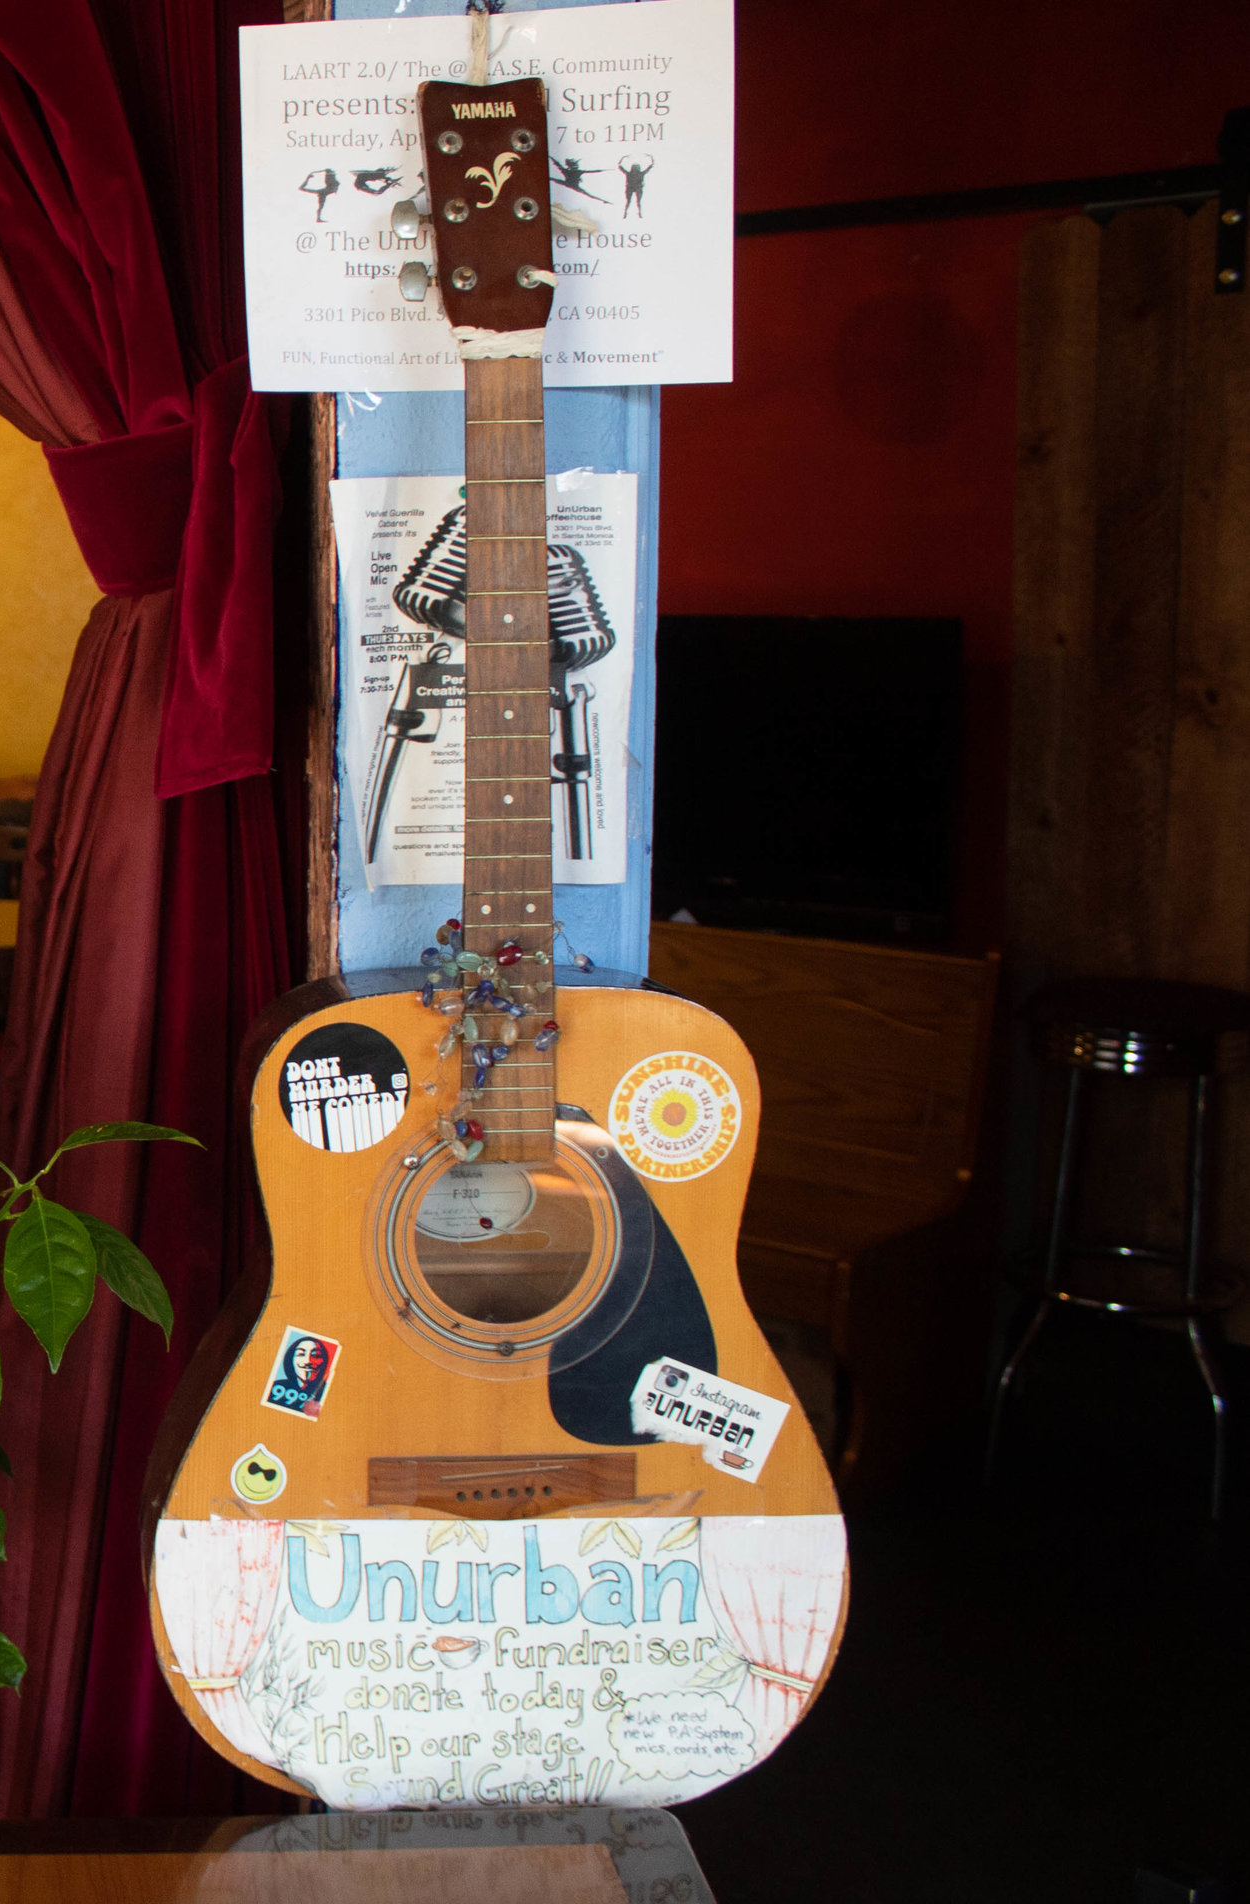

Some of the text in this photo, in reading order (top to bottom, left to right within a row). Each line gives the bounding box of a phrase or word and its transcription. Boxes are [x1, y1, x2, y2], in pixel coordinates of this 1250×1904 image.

[282, 61, 351, 82] LAART
[357, 60, 399, 82] 2.0/
[404, 60, 442, 78] The
[552, 53, 673, 75] Community
[282, 94, 416, 124] presents:
[561, 85, 672, 117] Surfing
[451, 101, 517, 120] YAMAHA
[286, 128, 384, 152] Saturday,
[555, 125, 568, 145] 7
[574, 126, 596, 144] to
[604, 121, 664, 143] 11PM
[295, 231, 317, 253] @
[325, 230, 370, 252] The
[577, 229, 652, 249] House
[304, 307, 345, 322] 3301
[351, 307, 386, 322] Pico
[390, 307, 431, 322] Blvd.
[558, 306, 580, 320] CA
[585, 305, 640, 321] 90405
[282, 351, 316, 367] FUN,
[320, 351, 395, 366] Functional
[399, 351, 423, 365] Art
[425, 351, 442, 365] of
[556, 351, 568, 364] &
[557, 505, 602, 513] UnUrban
[404, 530, 418, 538] its
[370, 551, 392, 561] Live
[370, 563, 398, 574] Open
[370, 576, 388, 585] Mic
[382, 625, 399, 633] 2nd
[387, 643, 423, 652] month
[416, 686, 466, 697] Creativ
[591, 712, 606, 830] newcomers welcome and loved
[286, 1056, 341, 1083] DONT
[288, 1073, 377, 1103] MURDER
[614, 1054, 731, 1123] SUNSHINE
[648, 1075, 672, 1094] ALL
[679, 1075, 696, 1089] IN
[697, 1088, 715, 1121] THIS
[617, 1103, 737, 1178] PARTNERSHIPS
[648, 1124, 710, 1151] TOGETHER
[690, 1382, 762, 1421] Instagram
[286, 1524, 700, 1629] Unurban
[306, 1626, 718, 1672] music fundraiser
[343, 1667, 625, 1729] donate today &
[671, 1708, 708, 1723] need
[313, 1710, 585, 1774] Help our stage
[623, 1729, 655, 1739] new
[693, 1724, 744, 1743] System
